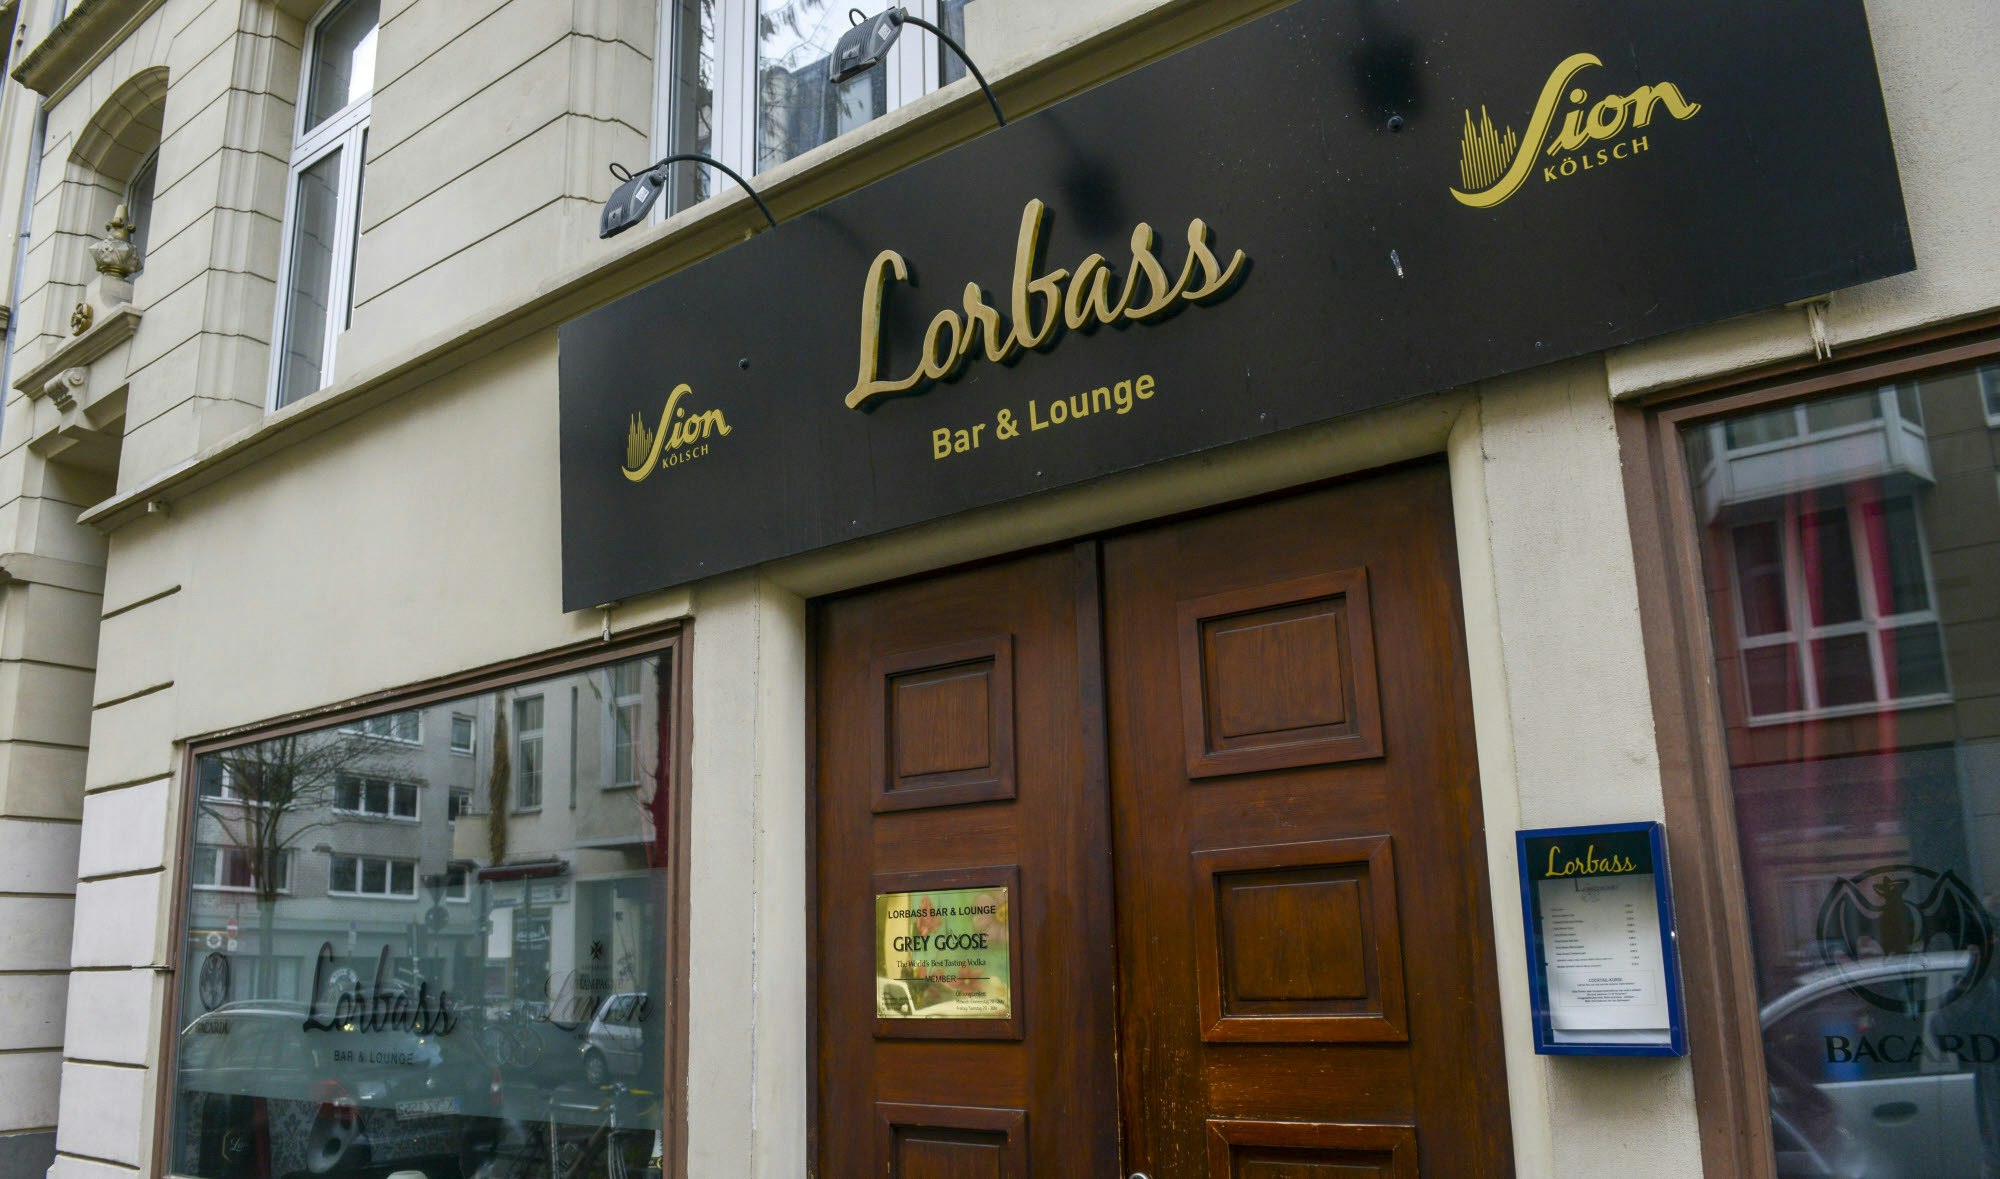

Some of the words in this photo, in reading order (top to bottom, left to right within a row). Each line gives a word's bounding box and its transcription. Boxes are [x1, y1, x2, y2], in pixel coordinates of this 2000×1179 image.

[1450, 52, 1702, 209] Sion
[1543, 135, 1650, 182] KÖLSCH
[844, 197, 1247, 409] Lorbass
[621, 383, 733, 482] Sion
[931, 422, 986, 460] Bar
[995, 407, 1020, 441] &
[1028, 373, 1156, 432] Lounge
[662, 444, 710, 469] KÖLSCH
[1545, 844, 1637, 877] Lorbass
[888, 909, 928, 919] LORBASS
[930, 907, 948, 917] BAR
[951, 907, 957, 916] &
[959, 905, 997, 916] LOUNGE
[893, 935, 931, 952] GREY
[934, 933, 989, 950] GOOSE
[924, 975, 957, 983] MEMBER
[944, 959, 967, 968] Tasting
[967, 958, 986, 966] Vodka
[303, 941, 457, 1036] Lorbass
[334, 1050, 353, 1062] BAR
[370, 1050, 413, 1066] LOUNGE
